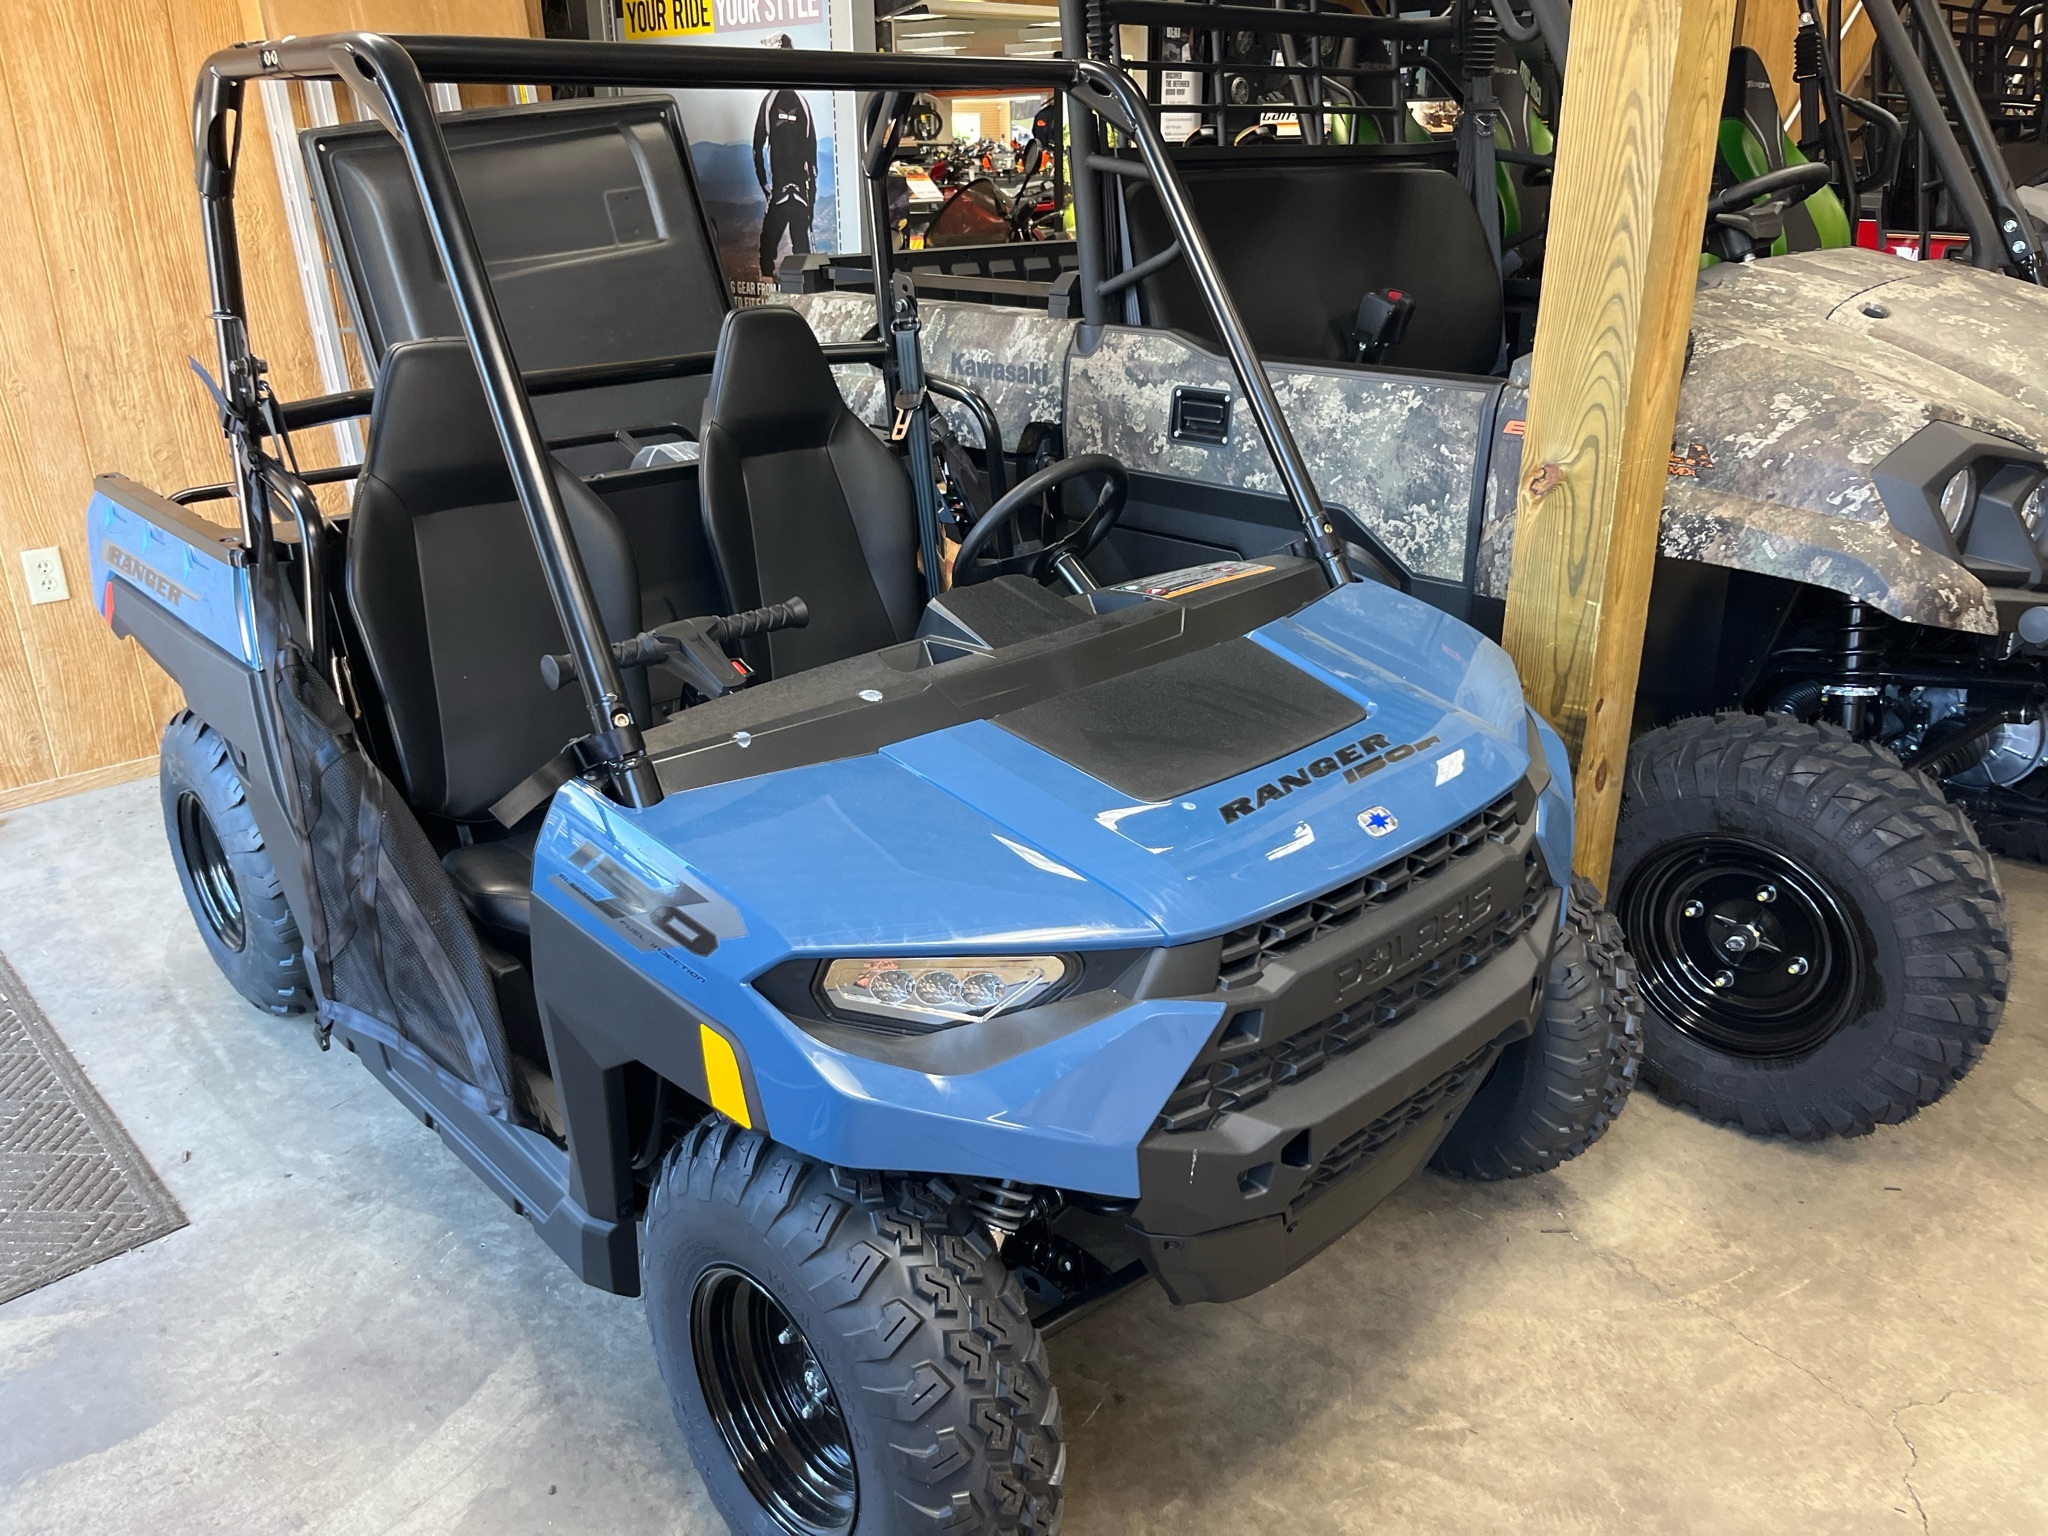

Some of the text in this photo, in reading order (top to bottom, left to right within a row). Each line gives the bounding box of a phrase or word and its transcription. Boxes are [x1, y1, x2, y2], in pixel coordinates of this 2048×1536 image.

[626, 0, 711, 33] YOUR RIDE
[715, 0, 820, 27] YOUR STYLE
[736, 281, 756, 295] GEAR
[756, 282, 777, 296] FROM
[950, 351, 1049, 387] Kawasaki
[106, 544, 184, 607] RANGER
[1218, 732, 1392, 826] RANGER
[1332, 883, 1493, 1004] POLARIS
